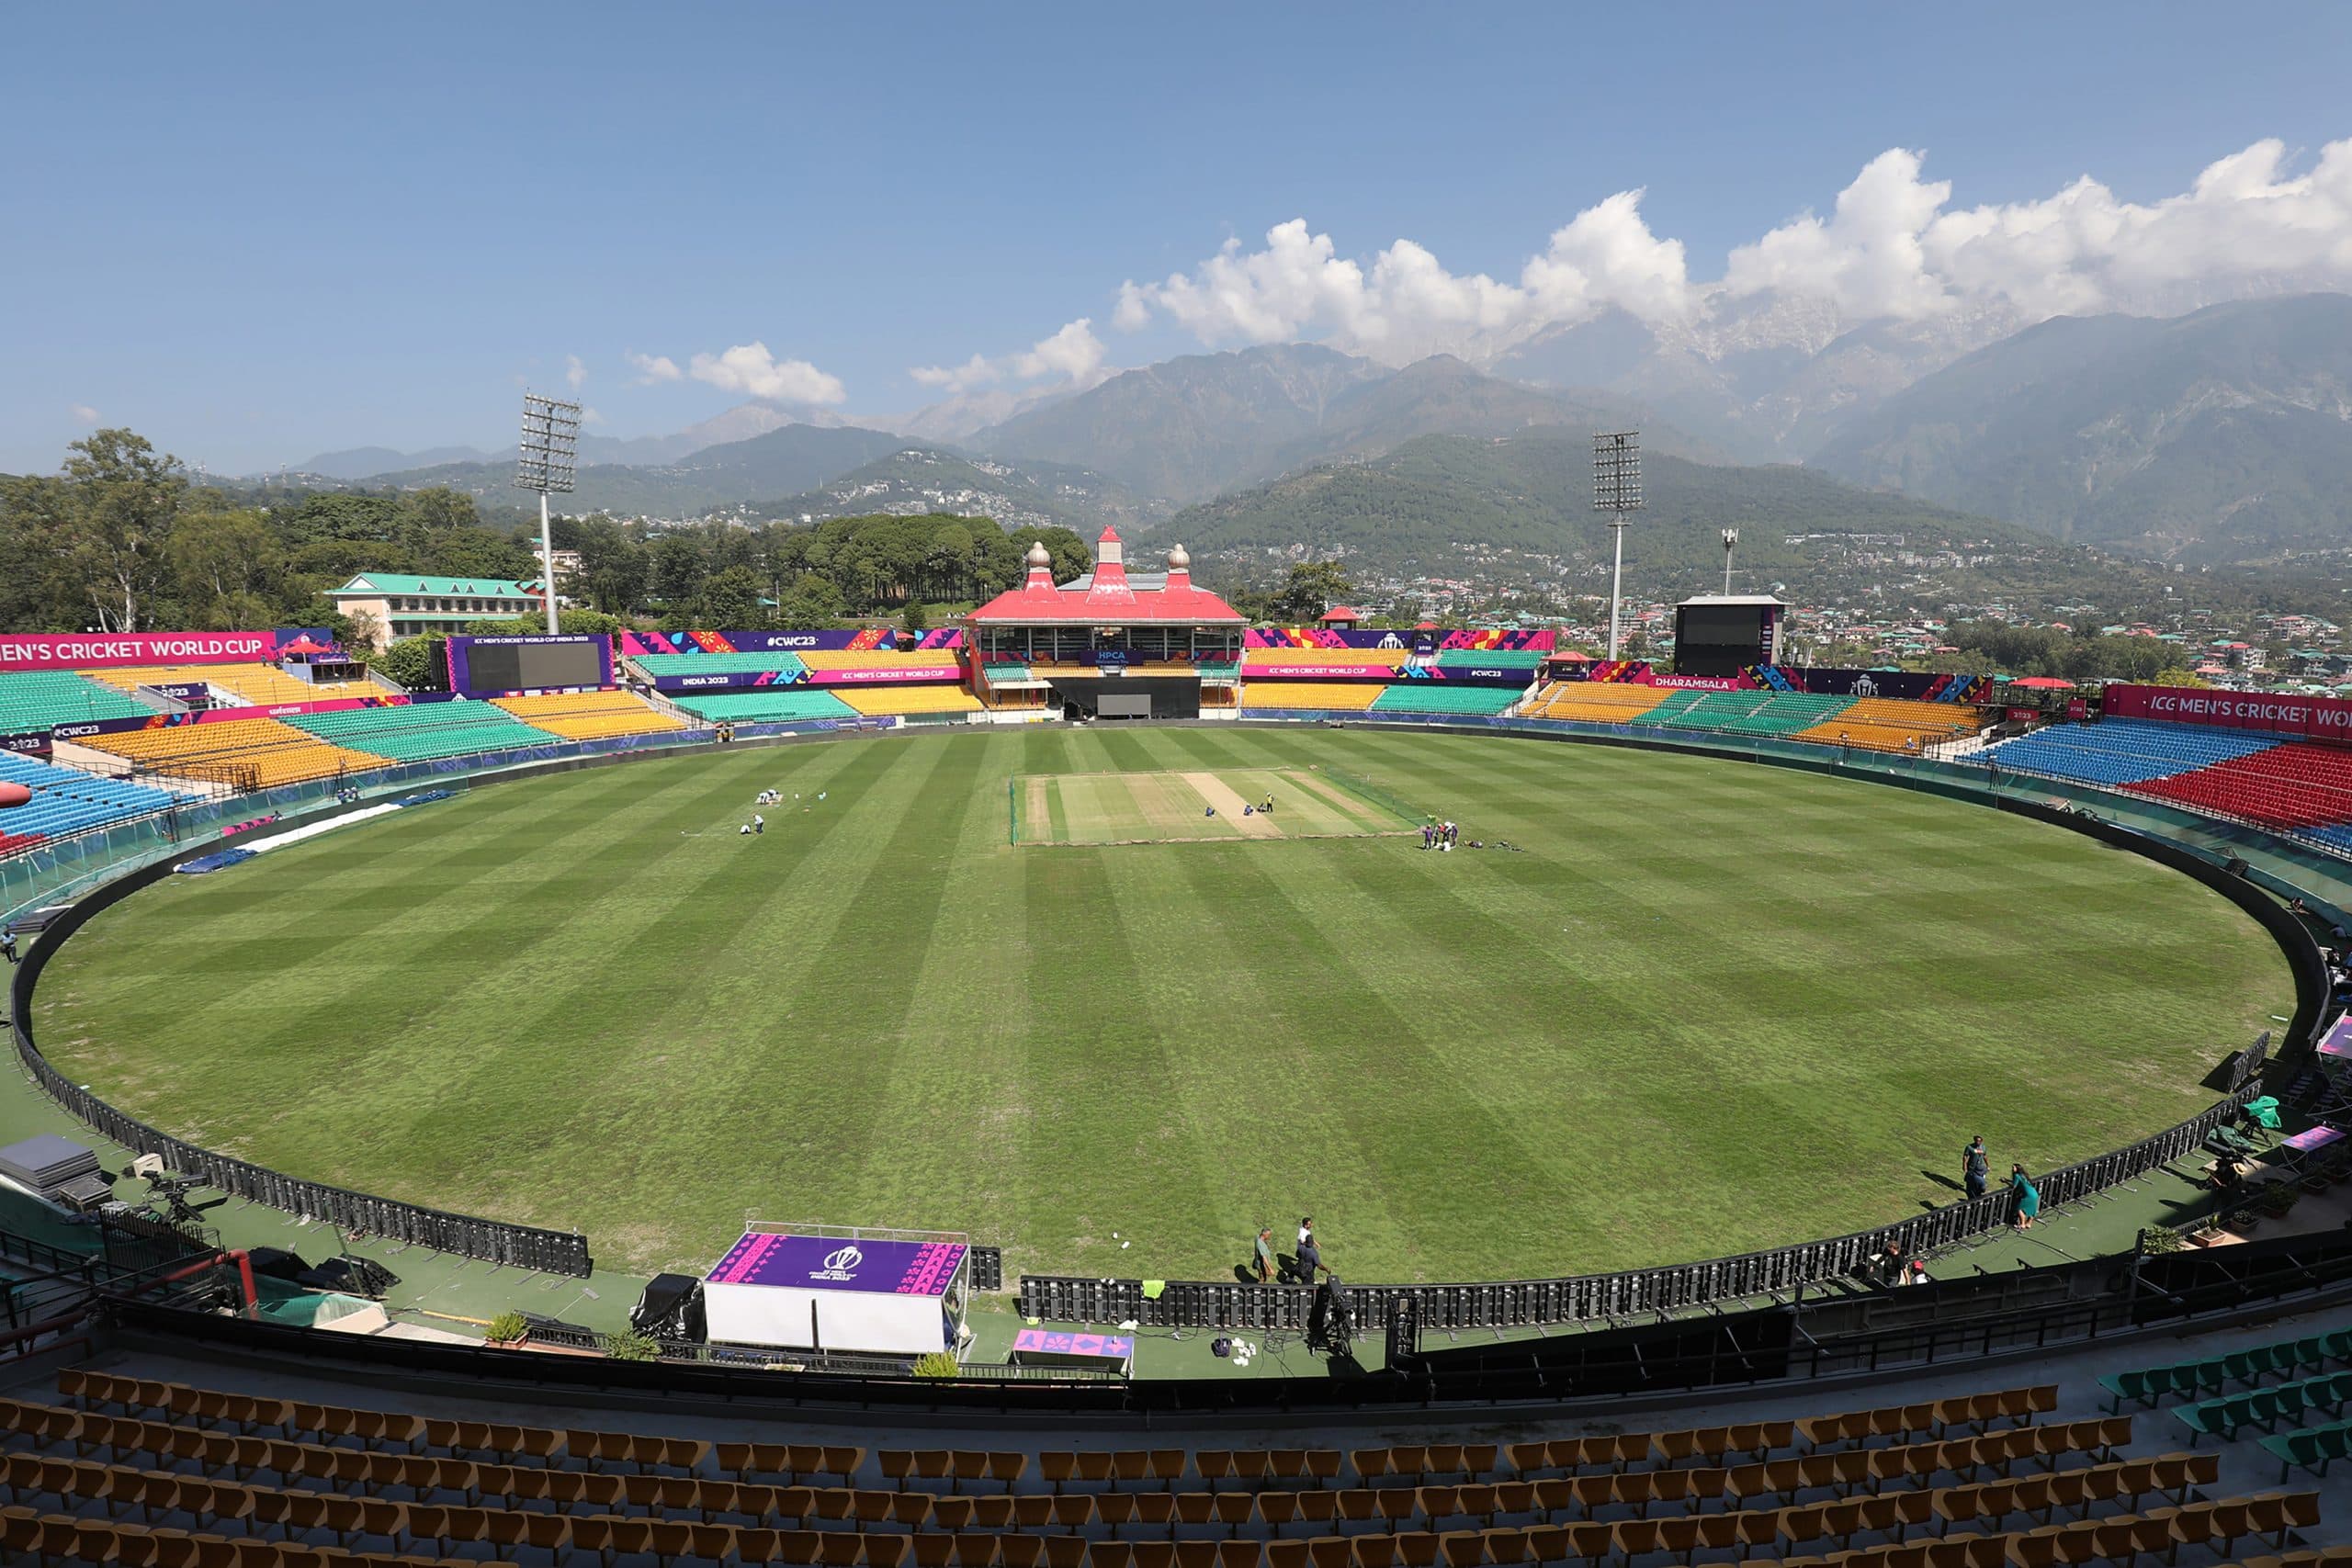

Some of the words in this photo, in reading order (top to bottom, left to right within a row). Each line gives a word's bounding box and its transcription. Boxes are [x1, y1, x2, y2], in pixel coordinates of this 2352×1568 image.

[767, 637, 816, 647] #CWC23
[56, 641, 143, 660] CRICKET
[149, 639, 222, 656] WORLD
[225, 639, 263, 655] CUP
[1099, 651, 1125, 660] HPCA
[683, 677, 707, 685] INDIA
[707, 676, 729, 684] 2023
[1656, 678, 1729, 689] DHARAMSALA
[2150, 695, 2176, 711] ICC
[2179, 697, 2232, 716] MEN'S
[2235, 702, 2312, 723] CRICKET
[54, 725, 99, 737] #CWC23
